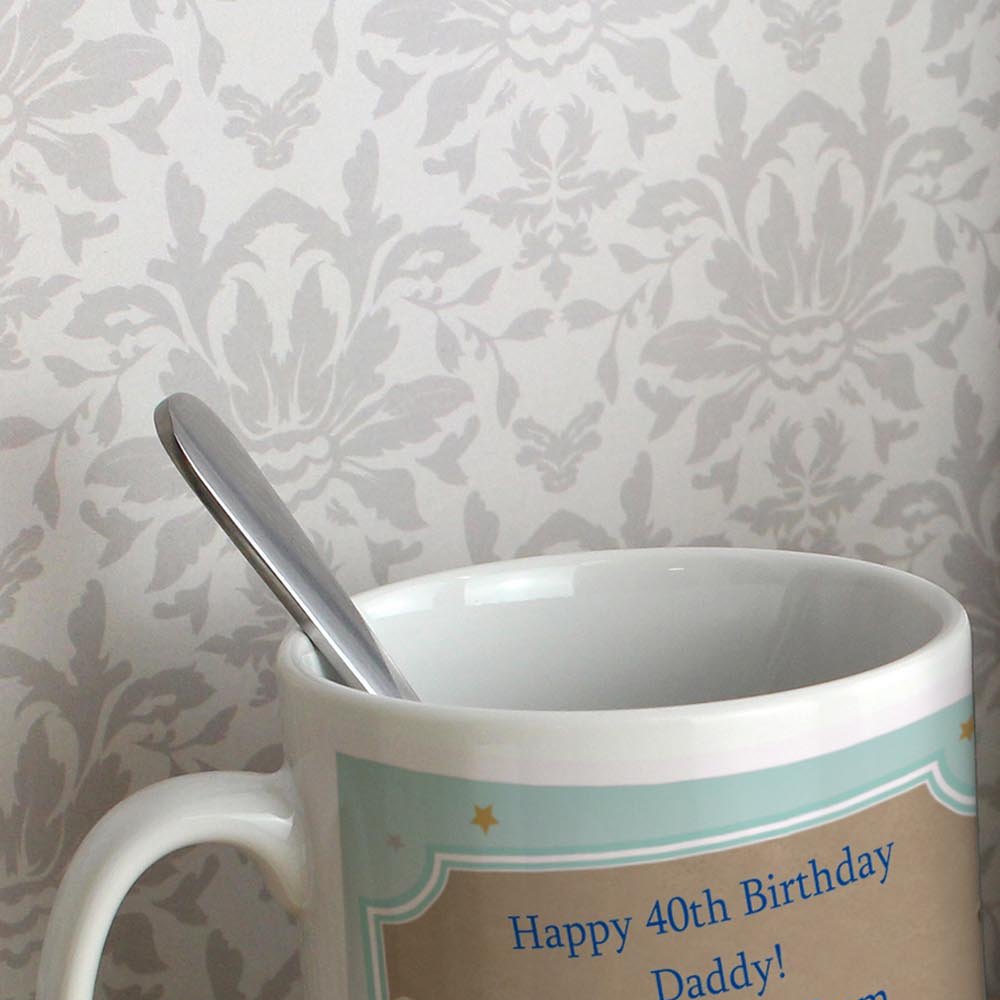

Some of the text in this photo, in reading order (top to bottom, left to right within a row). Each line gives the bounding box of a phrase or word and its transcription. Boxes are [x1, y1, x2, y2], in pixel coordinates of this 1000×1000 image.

[508, 841, 895, 958] Happy 40th Birthday
